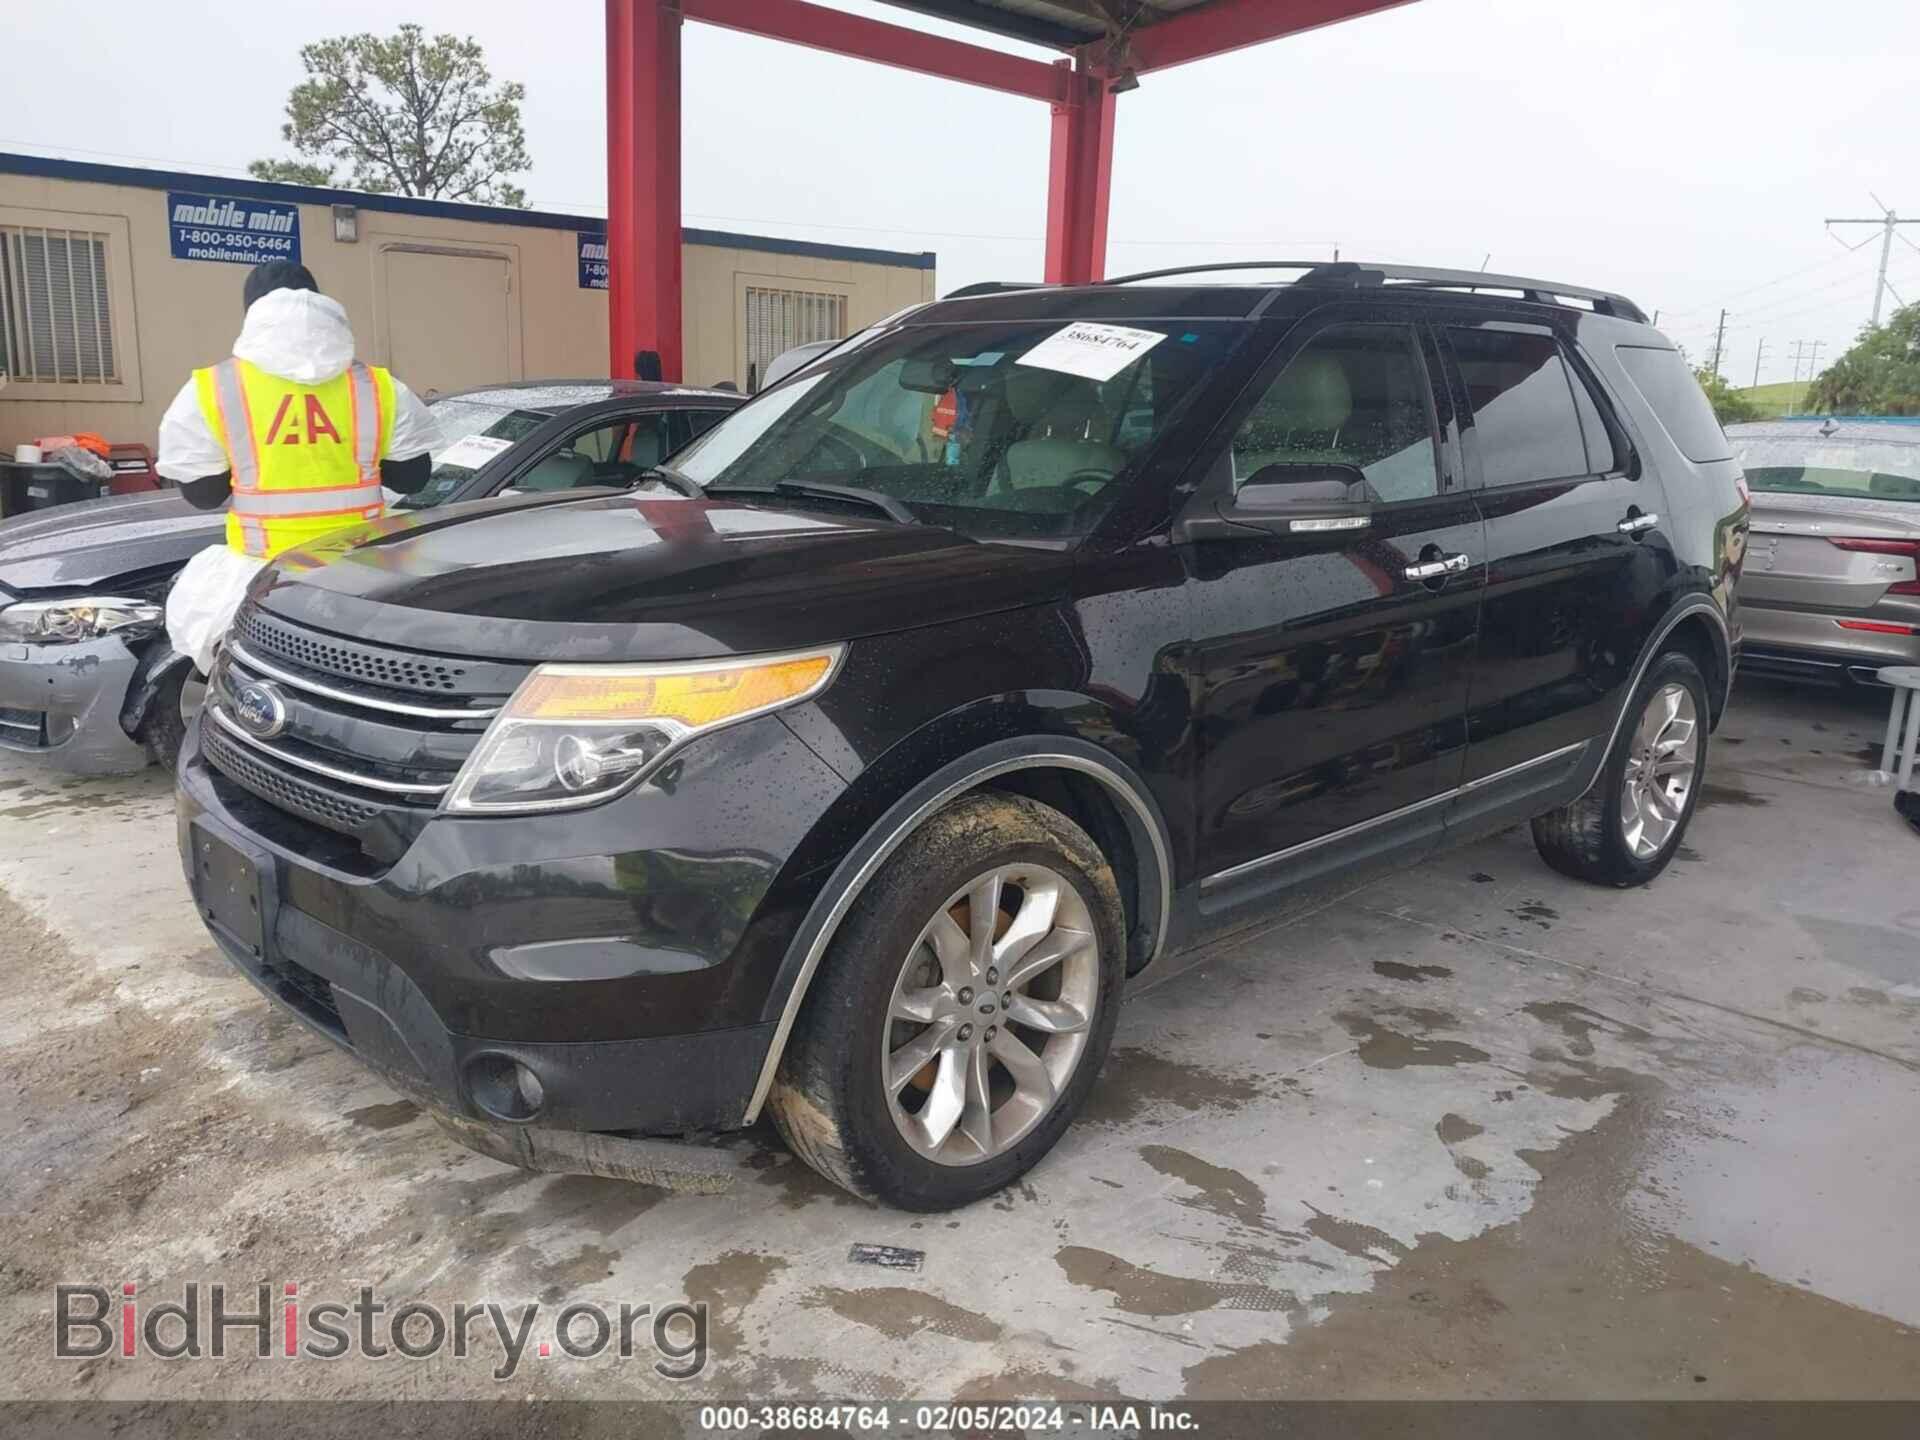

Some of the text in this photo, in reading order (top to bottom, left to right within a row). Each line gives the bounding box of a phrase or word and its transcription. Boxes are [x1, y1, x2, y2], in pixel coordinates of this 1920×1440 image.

[173, 199, 294, 233] mobile mini
[180, 229, 291, 251] 1-800-950-6464
